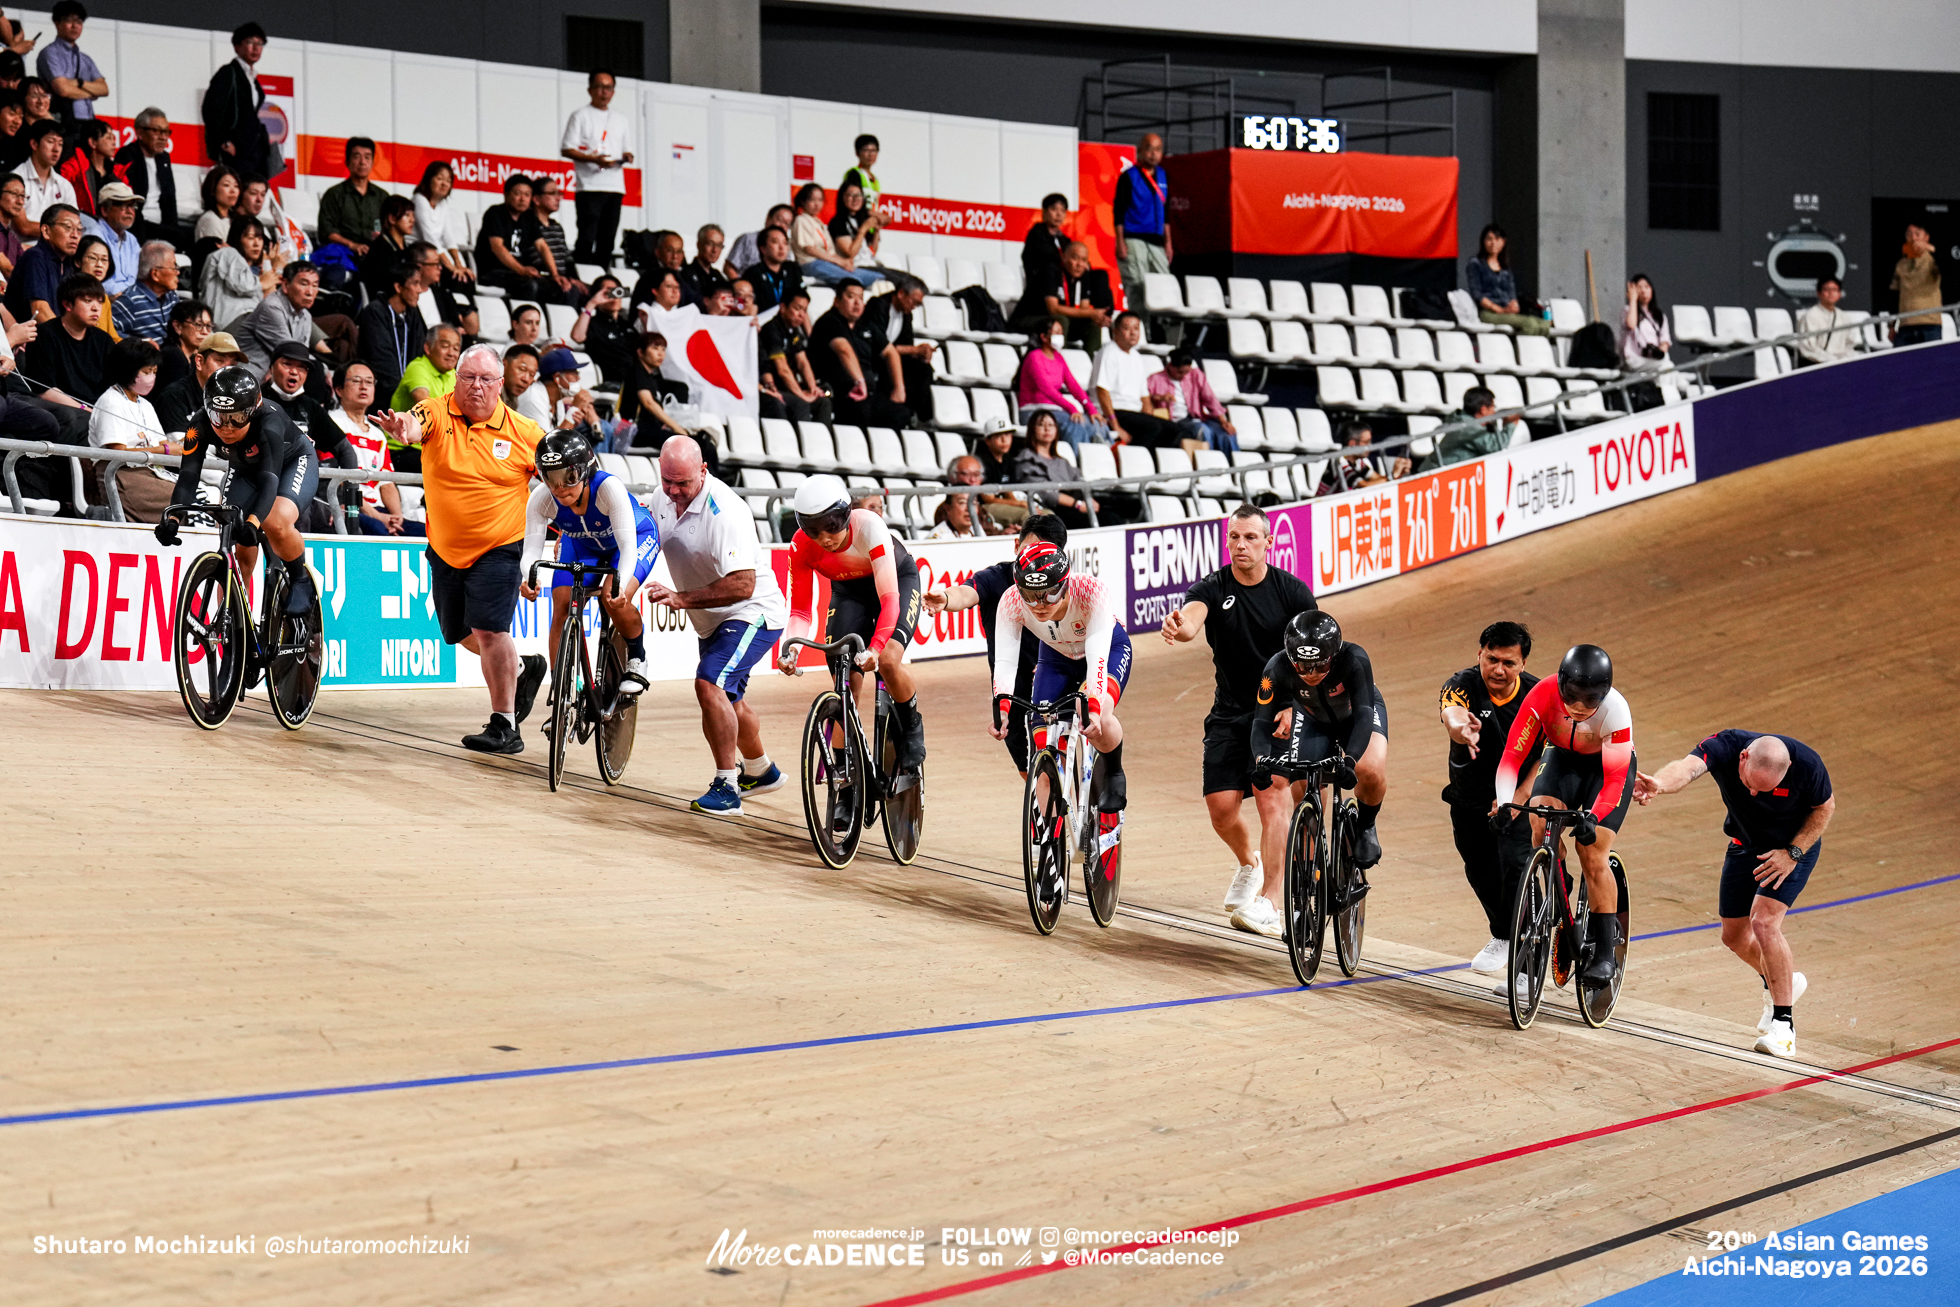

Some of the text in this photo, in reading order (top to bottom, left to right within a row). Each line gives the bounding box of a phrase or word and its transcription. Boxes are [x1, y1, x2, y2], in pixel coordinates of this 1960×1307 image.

[1243, 115, 1340, 153] 16:07:36
[965, 208, 1006, 233] 2026
[1282, 192, 1406, 213] Aichi-Nagoya 2026
[1588, 421, 1688, 496] TOYOTA
[1516, 461, 1577, 520] 中部電力
[1130, 521, 1220, 592] BORNAN
[1320, 492, 1393, 588] JR東海
[906, 588, 921, 630] CHINA
[1134, 594, 1167, 627] SPORTS
[381, 638, 441, 677] NITORI
[1095, 657, 1106, 694] JAPAN
[1116, 644, 1133, 683] JAPAN
[1514, 715, 1536, 752] CHINA
